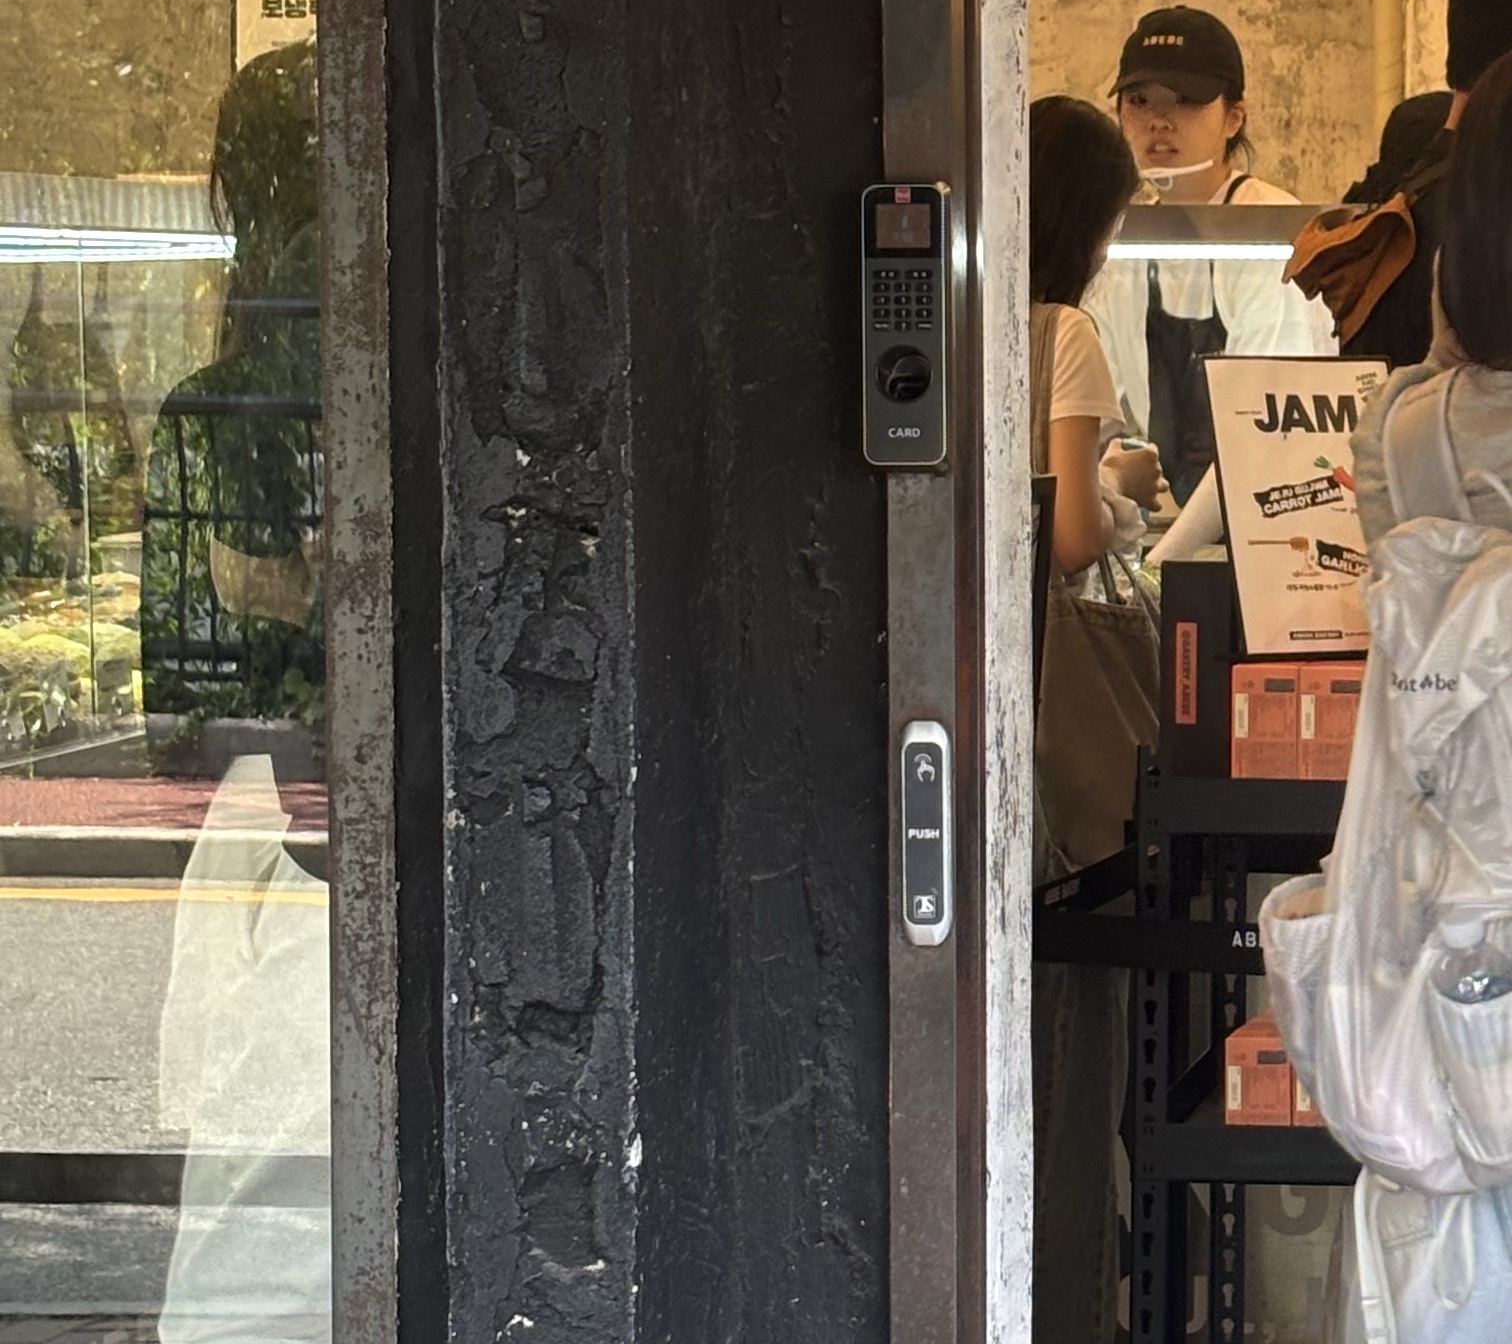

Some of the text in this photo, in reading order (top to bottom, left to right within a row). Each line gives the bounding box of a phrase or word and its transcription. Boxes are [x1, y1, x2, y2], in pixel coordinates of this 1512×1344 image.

[1254, 393, 1359, 434] JAM
[888, 427, 921, 439] CARD
[1264, 495, 1313, 515] CARROT
[1315, 488, 1342, 504] JAM
[908, 828, 940, 840] PUSH
[1232, 930, 1263, 948] AB
